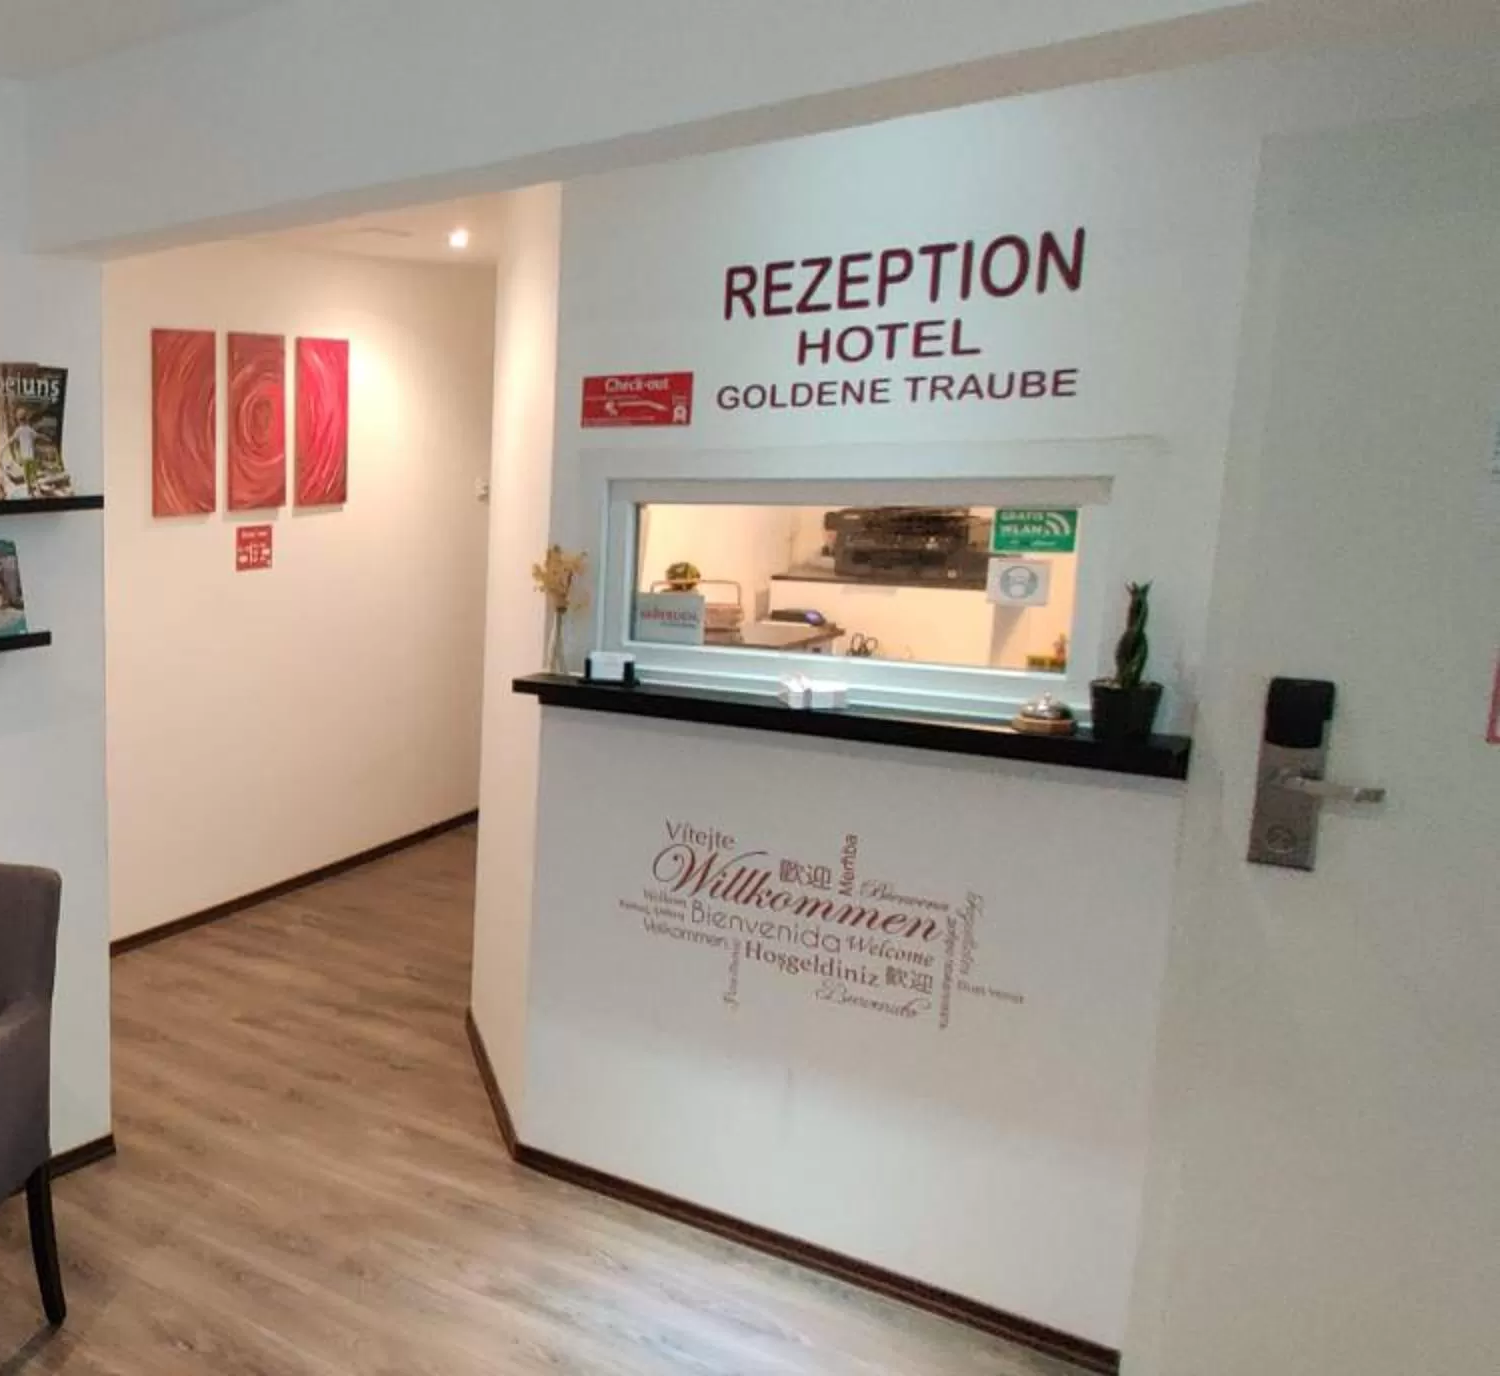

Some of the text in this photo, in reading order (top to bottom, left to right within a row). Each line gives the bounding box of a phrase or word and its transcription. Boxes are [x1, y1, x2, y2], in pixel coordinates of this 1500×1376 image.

[723, 228, 1086, 320] REZEPTION
[797, 319, 981, 365] HOTEL
[716, 368, 1079, 409] GOLDENE TRAUBE
[652, 844, 945, 943] Willkommen
[690, 899, 841, 953] Bienvenida
[846, 935, 935, 968] Welcome
